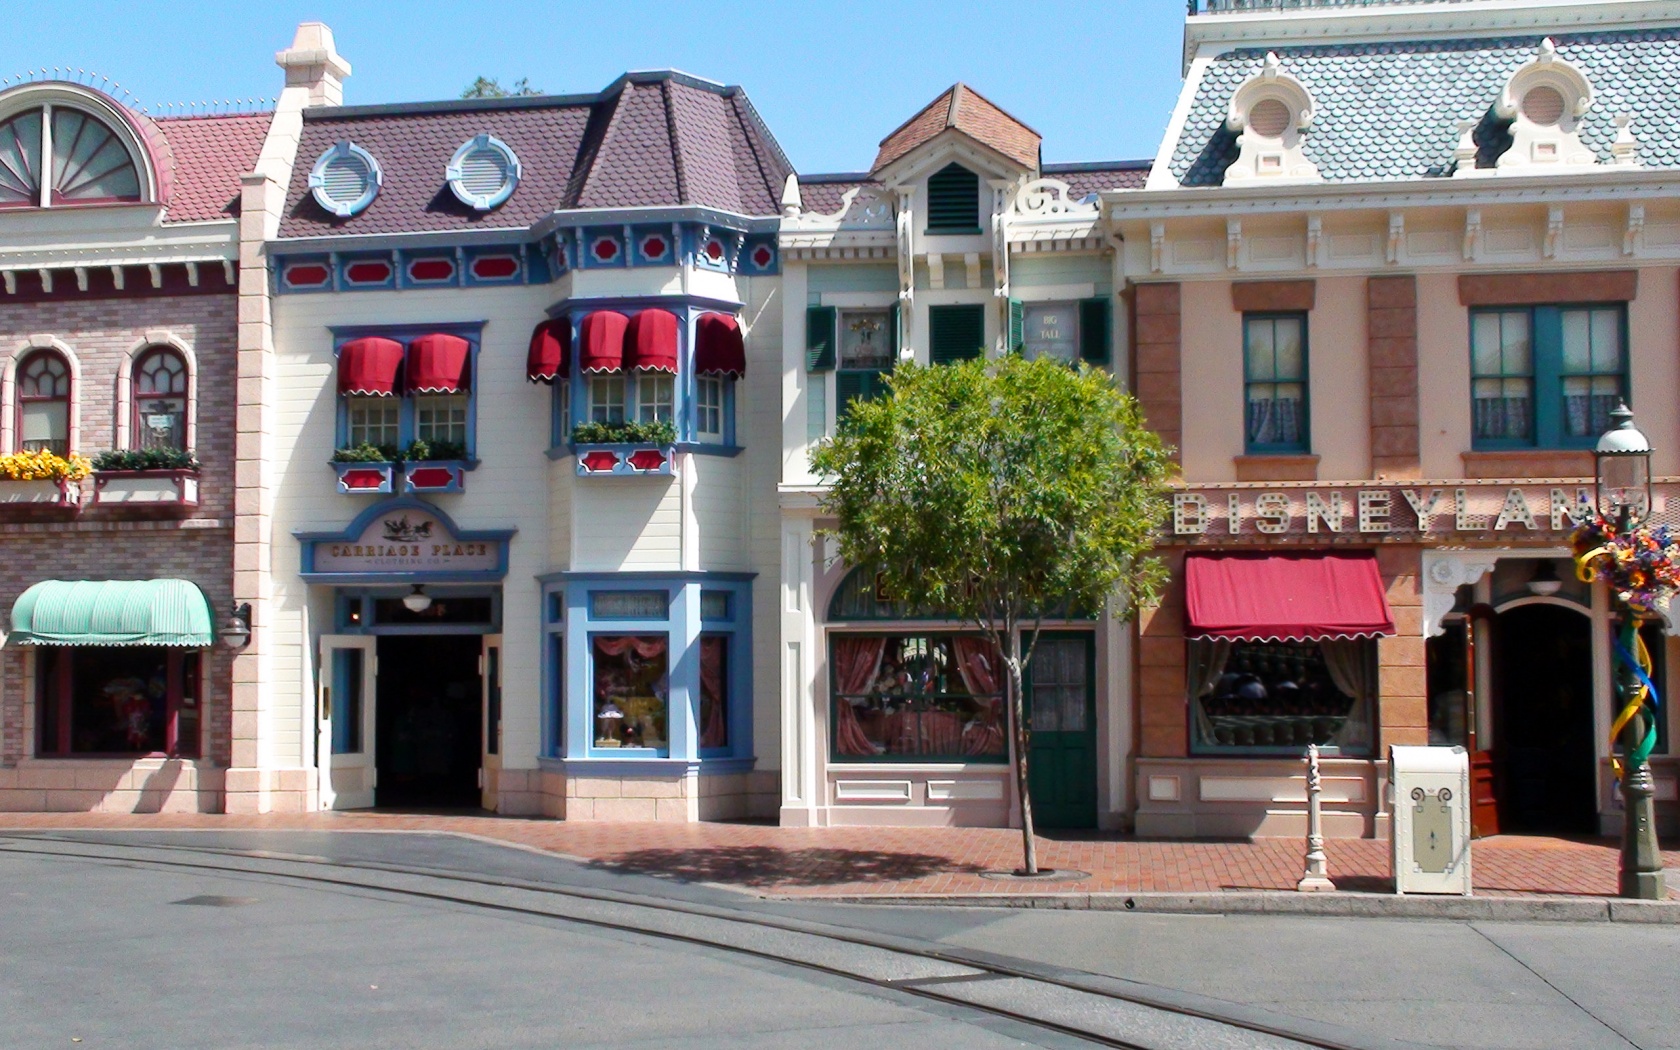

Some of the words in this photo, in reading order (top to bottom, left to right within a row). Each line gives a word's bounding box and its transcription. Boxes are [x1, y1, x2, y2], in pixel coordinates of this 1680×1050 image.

[1172, 486, 1645, 535] DISNEYLAN
[331, 545, 420, 557] CARRIAGE
[431, 544, 486, 556] PLACE
[374, 557, 423, 565] CLOTHING
